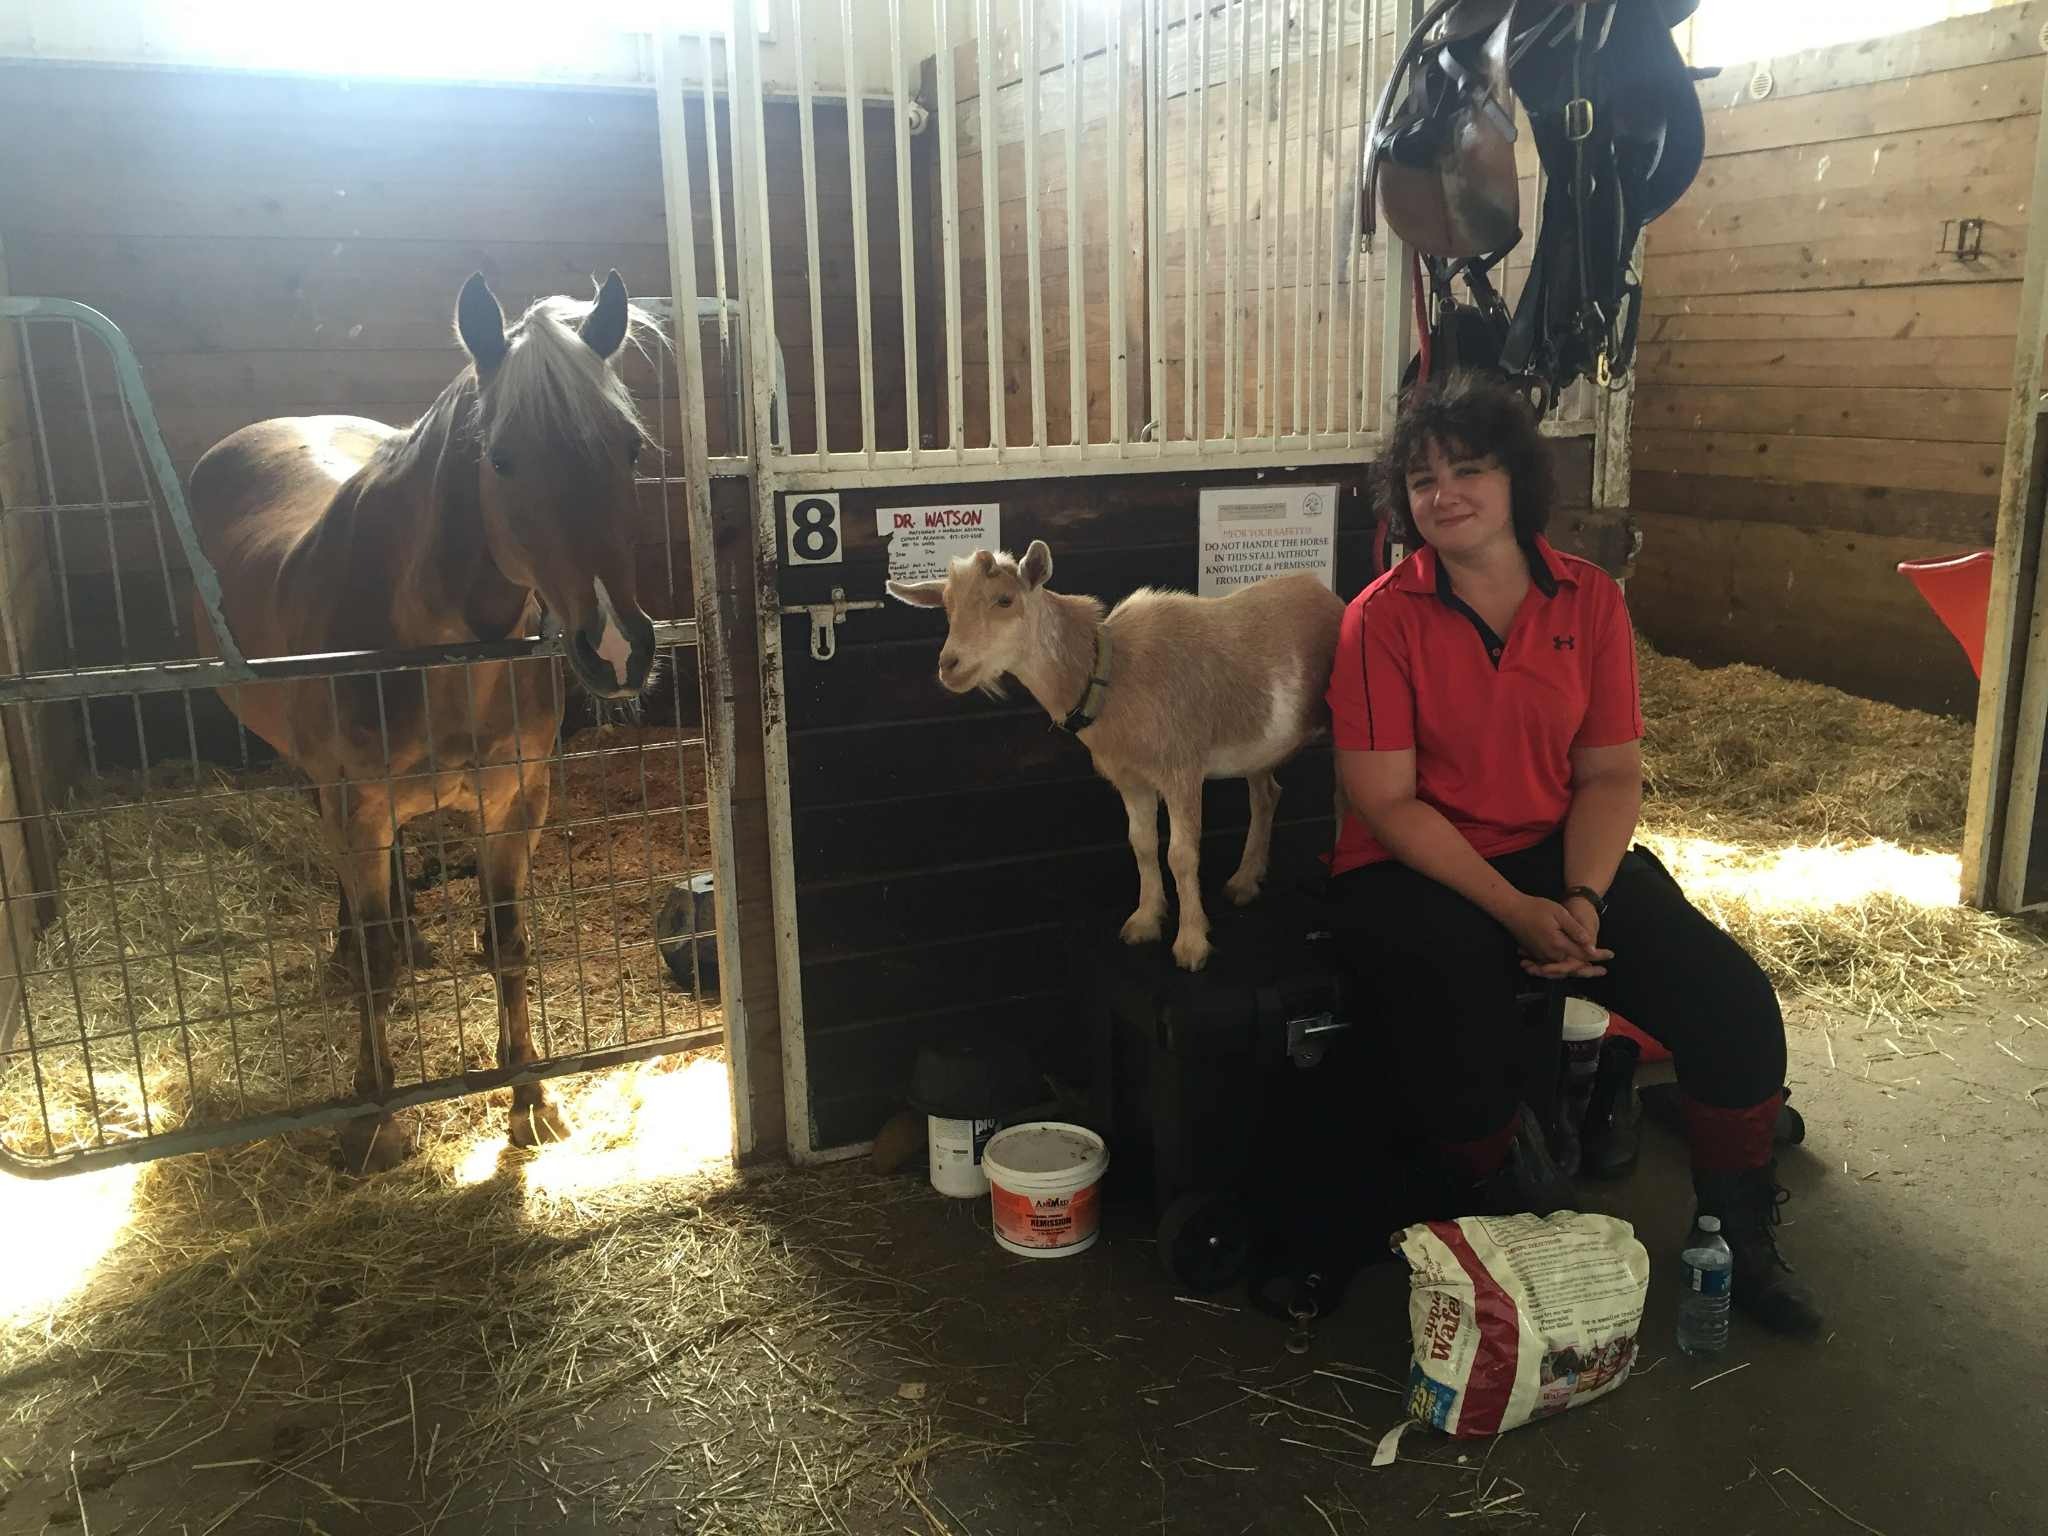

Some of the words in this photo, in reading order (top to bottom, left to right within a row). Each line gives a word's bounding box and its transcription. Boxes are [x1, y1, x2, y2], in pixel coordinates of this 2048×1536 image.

[893, 513, 916, 528] DR.
[925, 509, 982, 527] WATSON
[792, 498, 838, 560] 8
[1205, 543, 1219, 552] DO
[1220, 542, 1240, 551] NOT
[1242, 540, 1279, 549] HANDLE
[1279, 539, 1297, 548] THE
[1299, 537, 1329, 546] HORSE
[1215, 554, 1224, 562] IN
[1227, 552, 1248, 561] THIS
[1249, 551, 1278, 560] STALL
[1278, 549, 1319, 559] WITHOUT
[1206, 564, 1264, 574] KNOWLEDGE
[1274, 560, 1327, 570] PERMISSION
[1216, 576, 1242, 585] FROM
[1031, 1216, 1072, 1228] REMISSION
